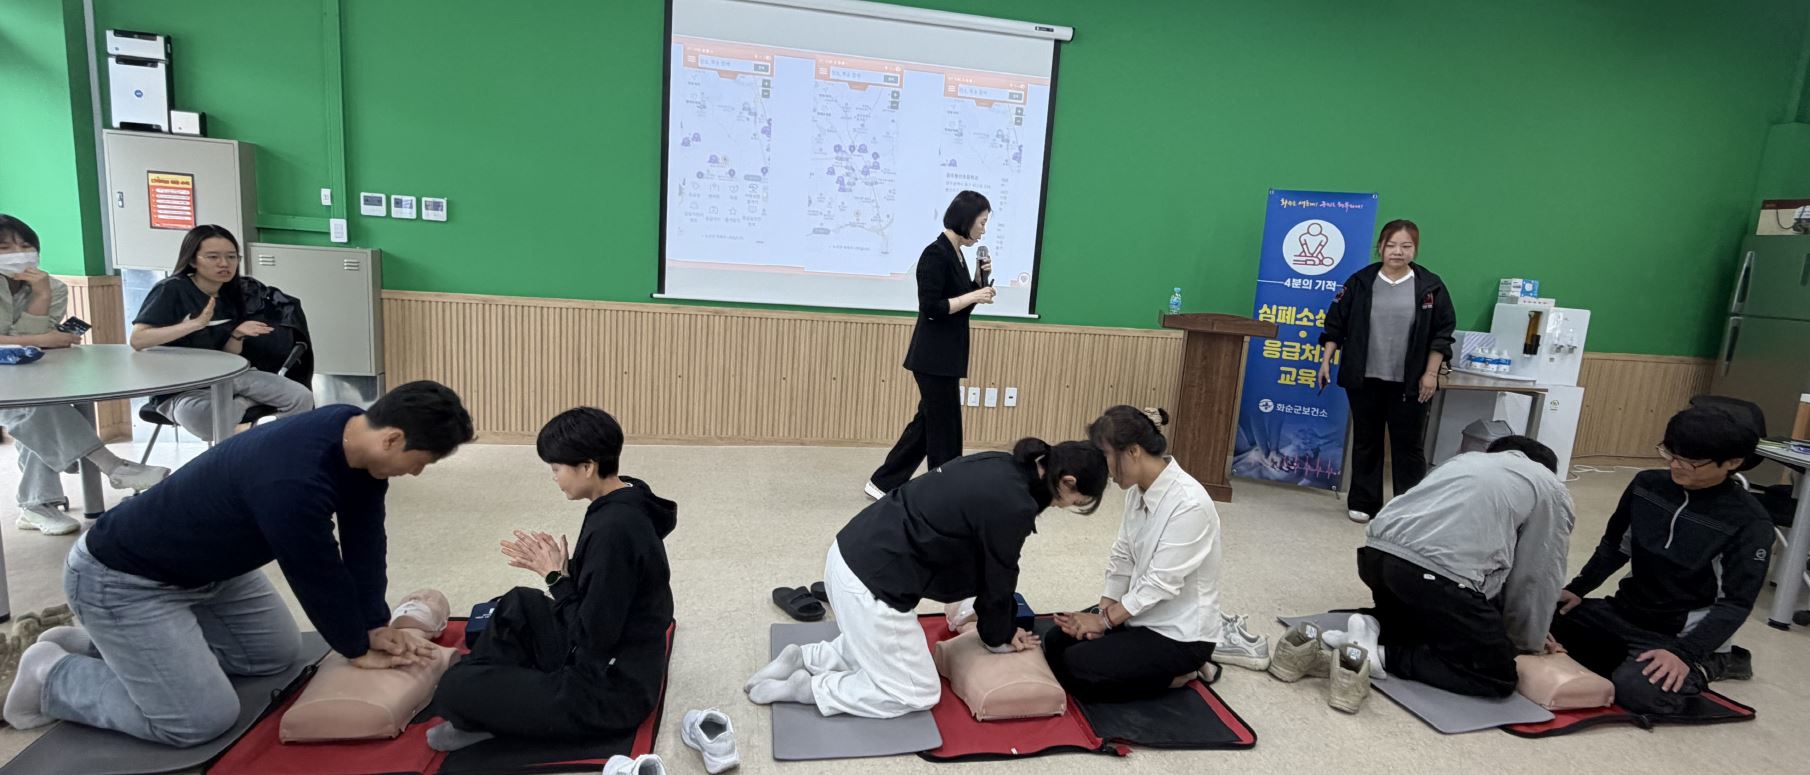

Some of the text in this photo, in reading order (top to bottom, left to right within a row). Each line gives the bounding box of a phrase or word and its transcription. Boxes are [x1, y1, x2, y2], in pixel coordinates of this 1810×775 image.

[1284, 278, 1336, 291] 4분의 기적
[1278, 367, 1316, 388] 교육
[1276, 403, 1328, 417] 화순군보건소
